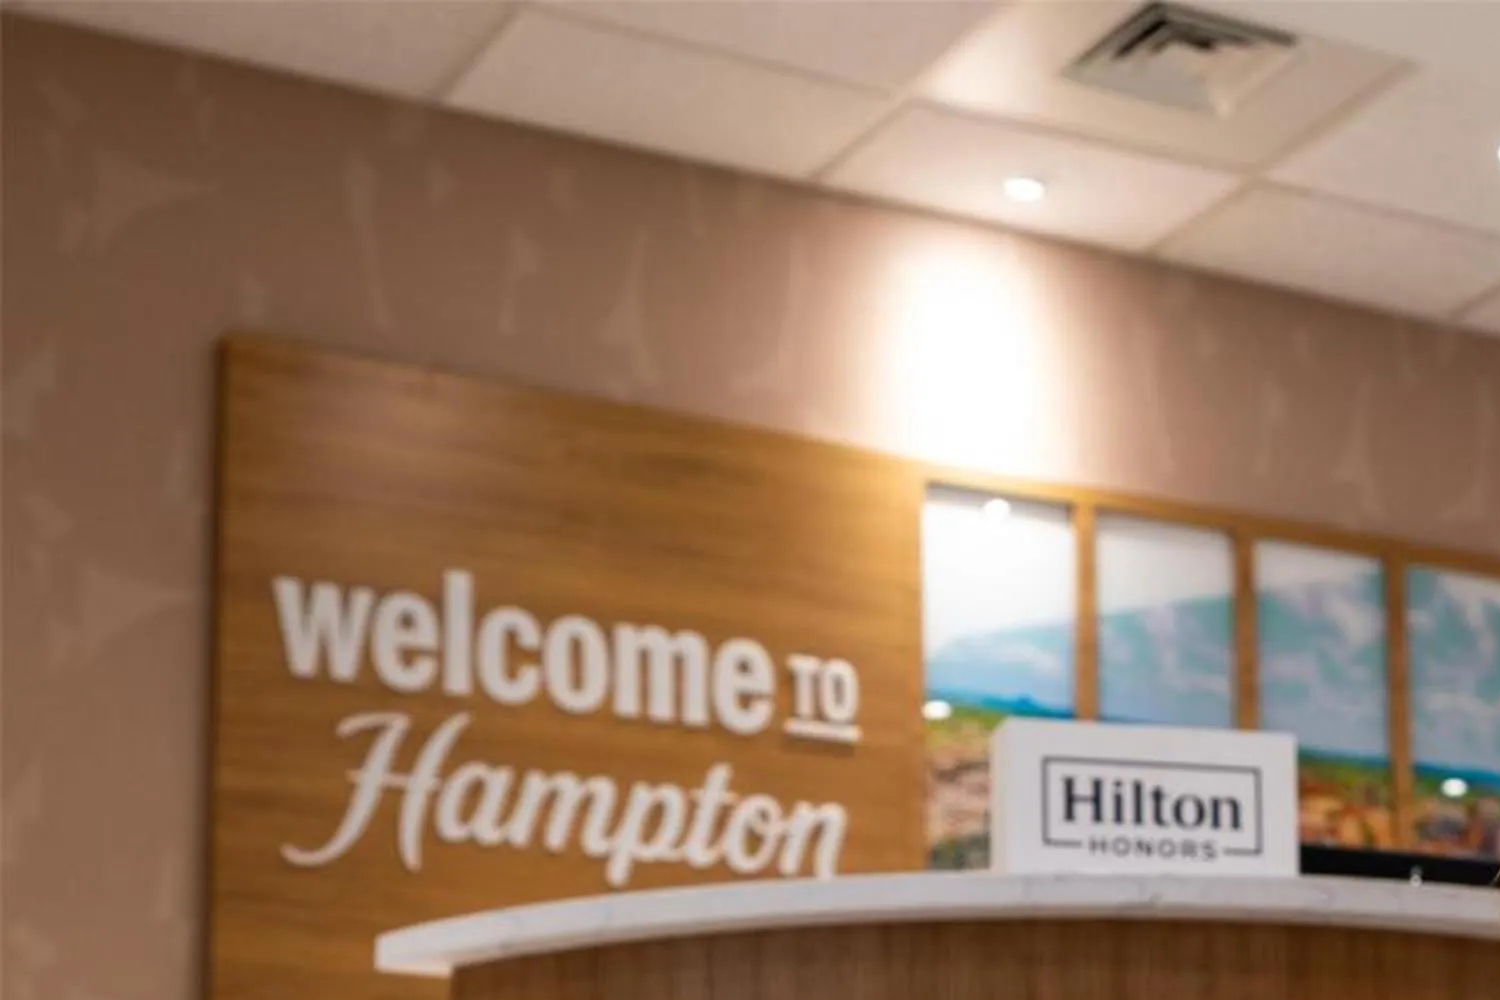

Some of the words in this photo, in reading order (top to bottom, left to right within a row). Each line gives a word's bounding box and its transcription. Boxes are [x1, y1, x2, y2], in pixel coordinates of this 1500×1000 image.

[272, 568, 776, 736] welcome
[787, 653, 862, 743] TO
[280, 711, 848, 889] Hampton
[1061, 775, 1243, 832] Hilton
[1088, 834, 1219, 862] HONORS
